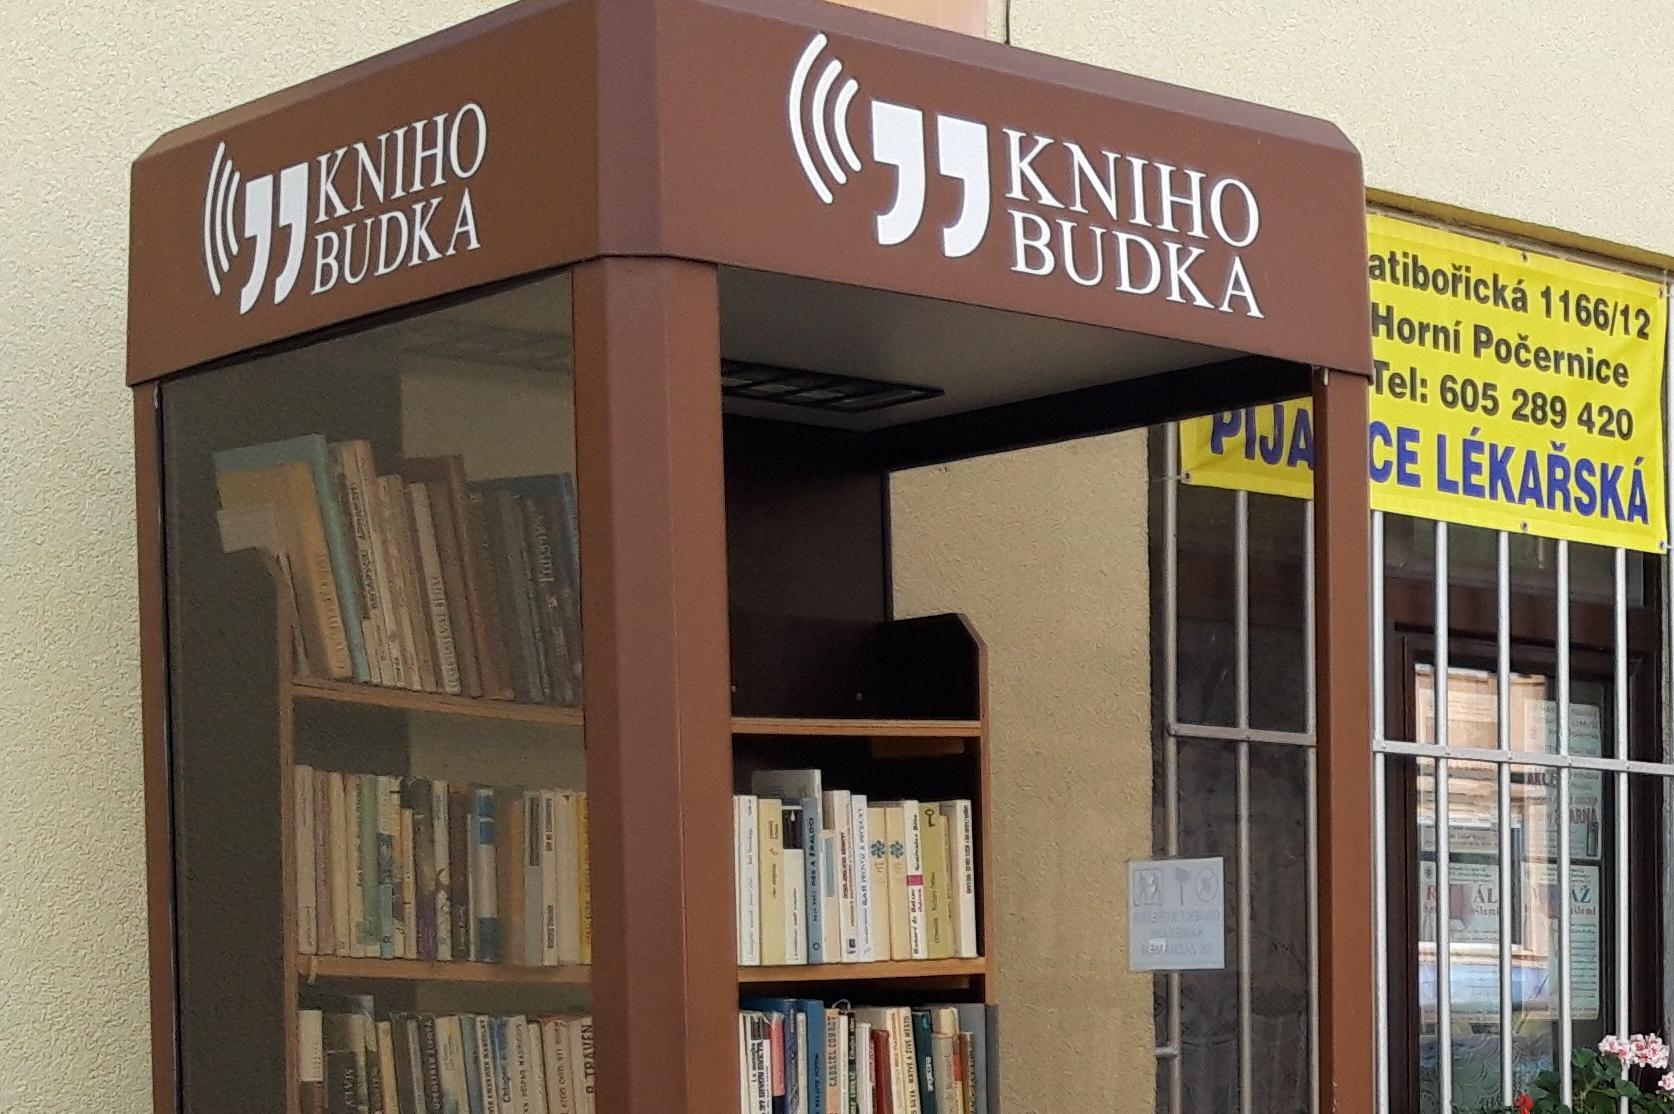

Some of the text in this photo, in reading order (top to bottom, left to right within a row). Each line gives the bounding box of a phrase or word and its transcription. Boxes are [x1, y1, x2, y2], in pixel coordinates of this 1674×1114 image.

[315, 101, 489, 218] KNIHO
[1003, 128, 1262, 249] KNIHO
[311, 187, 483, 297] BUDKA
[1007, 208, 1266, 320] BUDKA
[1368, 250, 1653, 341] atibořická 1166/12
[1370, 302, 1630, 388] Horní Počernice
[1372, 360, 1634, 441] Tel: 605 289 420
[1436, 426, 1651, 526] LÉKAŘSKÁ
